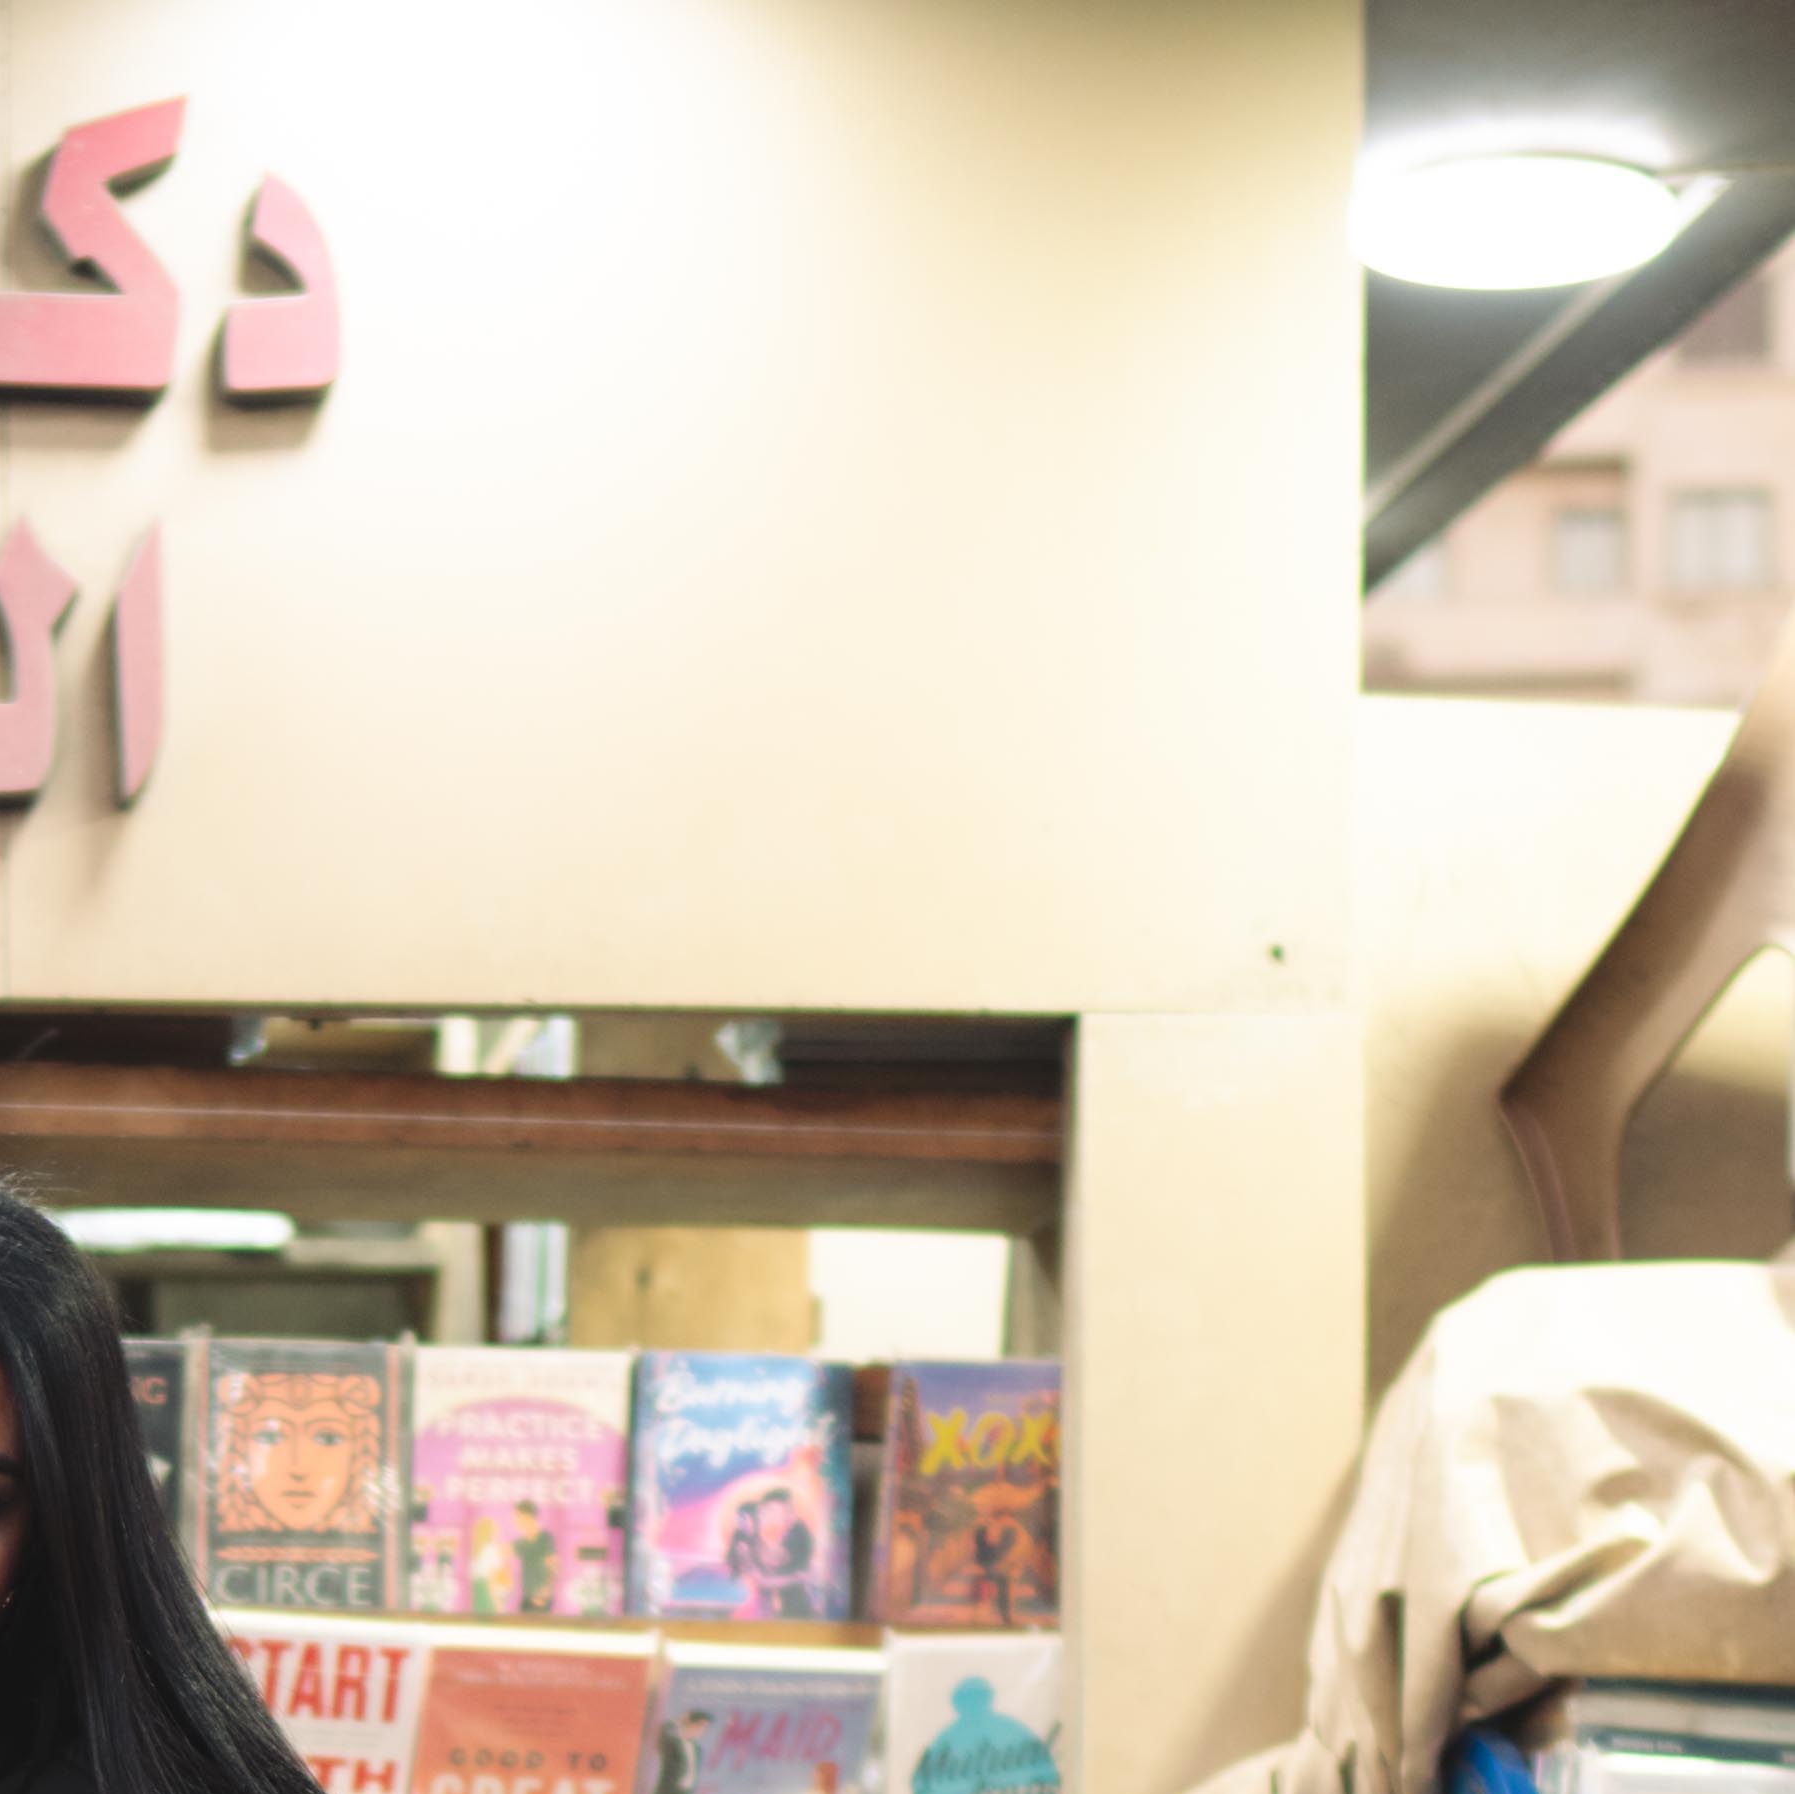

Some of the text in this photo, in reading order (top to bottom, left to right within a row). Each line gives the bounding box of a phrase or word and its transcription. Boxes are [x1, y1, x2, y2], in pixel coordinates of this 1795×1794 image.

[921, 1407, 1060, 1476] XOX
[215, 1564, 373, 1609] CIRCE
[450, 1746, 609, 1772] GOOD TO
